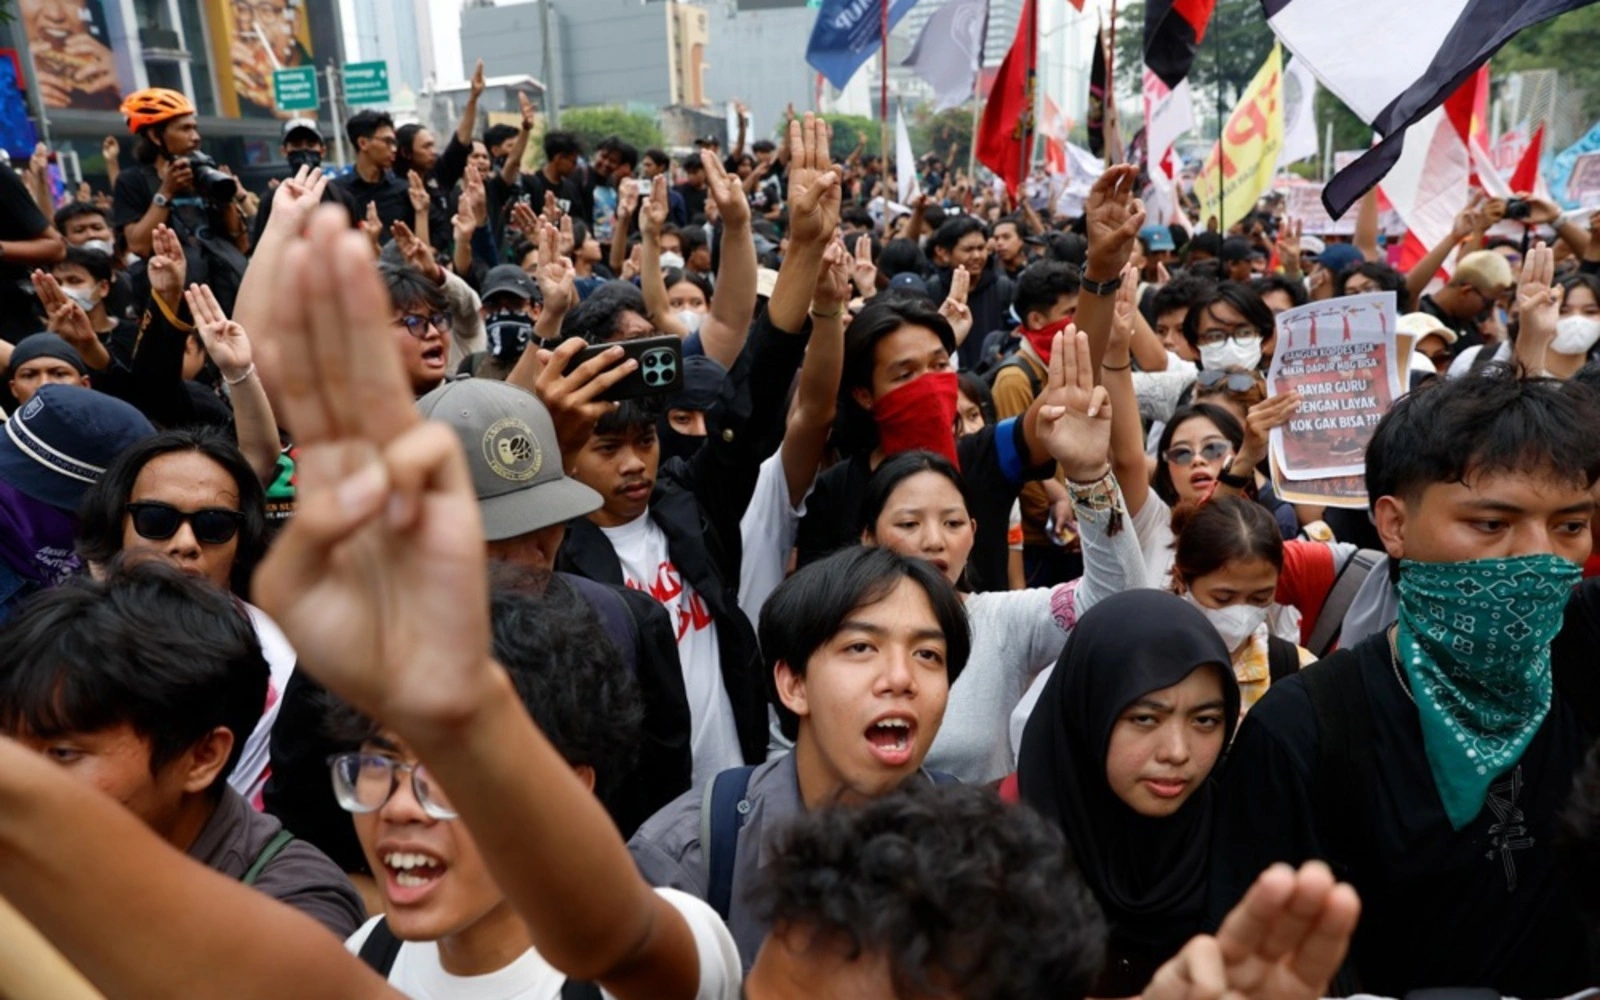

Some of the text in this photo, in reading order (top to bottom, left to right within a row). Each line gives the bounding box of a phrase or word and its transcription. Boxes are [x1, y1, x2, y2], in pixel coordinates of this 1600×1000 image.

[1306, 361, 1336, 374] DAPUR
[1359, 357, 1377, 369] BISA
[1297, 379, 1367, 396] BAYAR GURU
[1341, 396, 1376, 410] LAYAK
[1289, 419, 1313, 432] KOK
[1314, 417, 1338, 430] GAK
[1340, 415, 1365, 428] BISA
